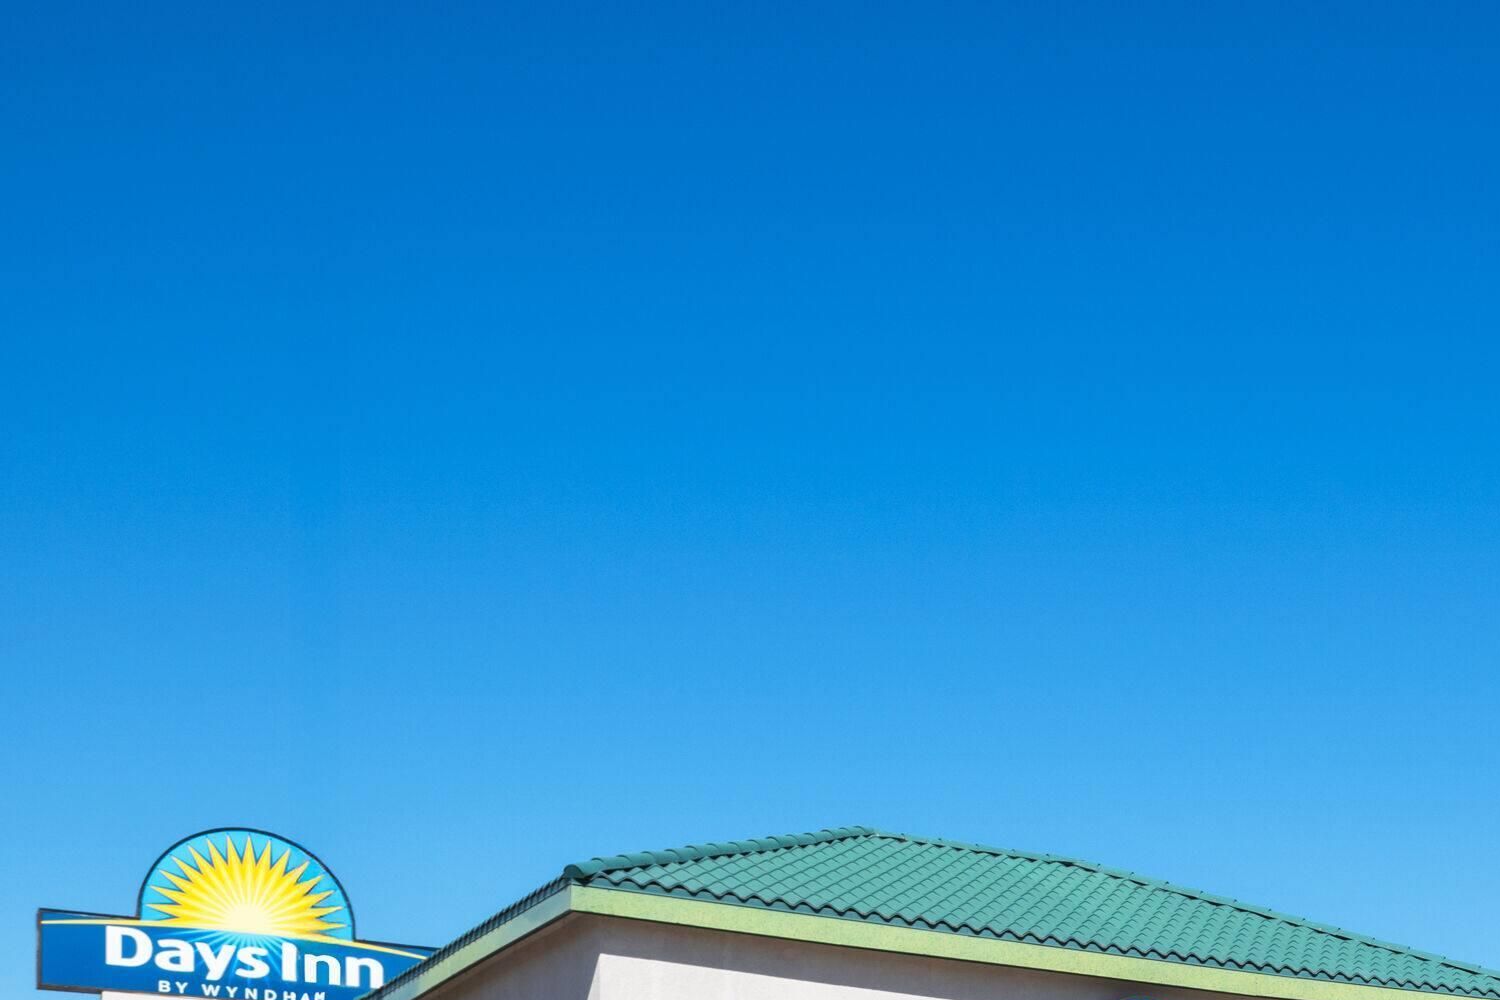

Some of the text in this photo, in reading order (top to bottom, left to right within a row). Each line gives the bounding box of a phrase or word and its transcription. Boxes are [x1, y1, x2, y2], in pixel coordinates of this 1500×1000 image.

[105, 925, 385, 989] Days Inn
[158, 980, 188, 995] BY
